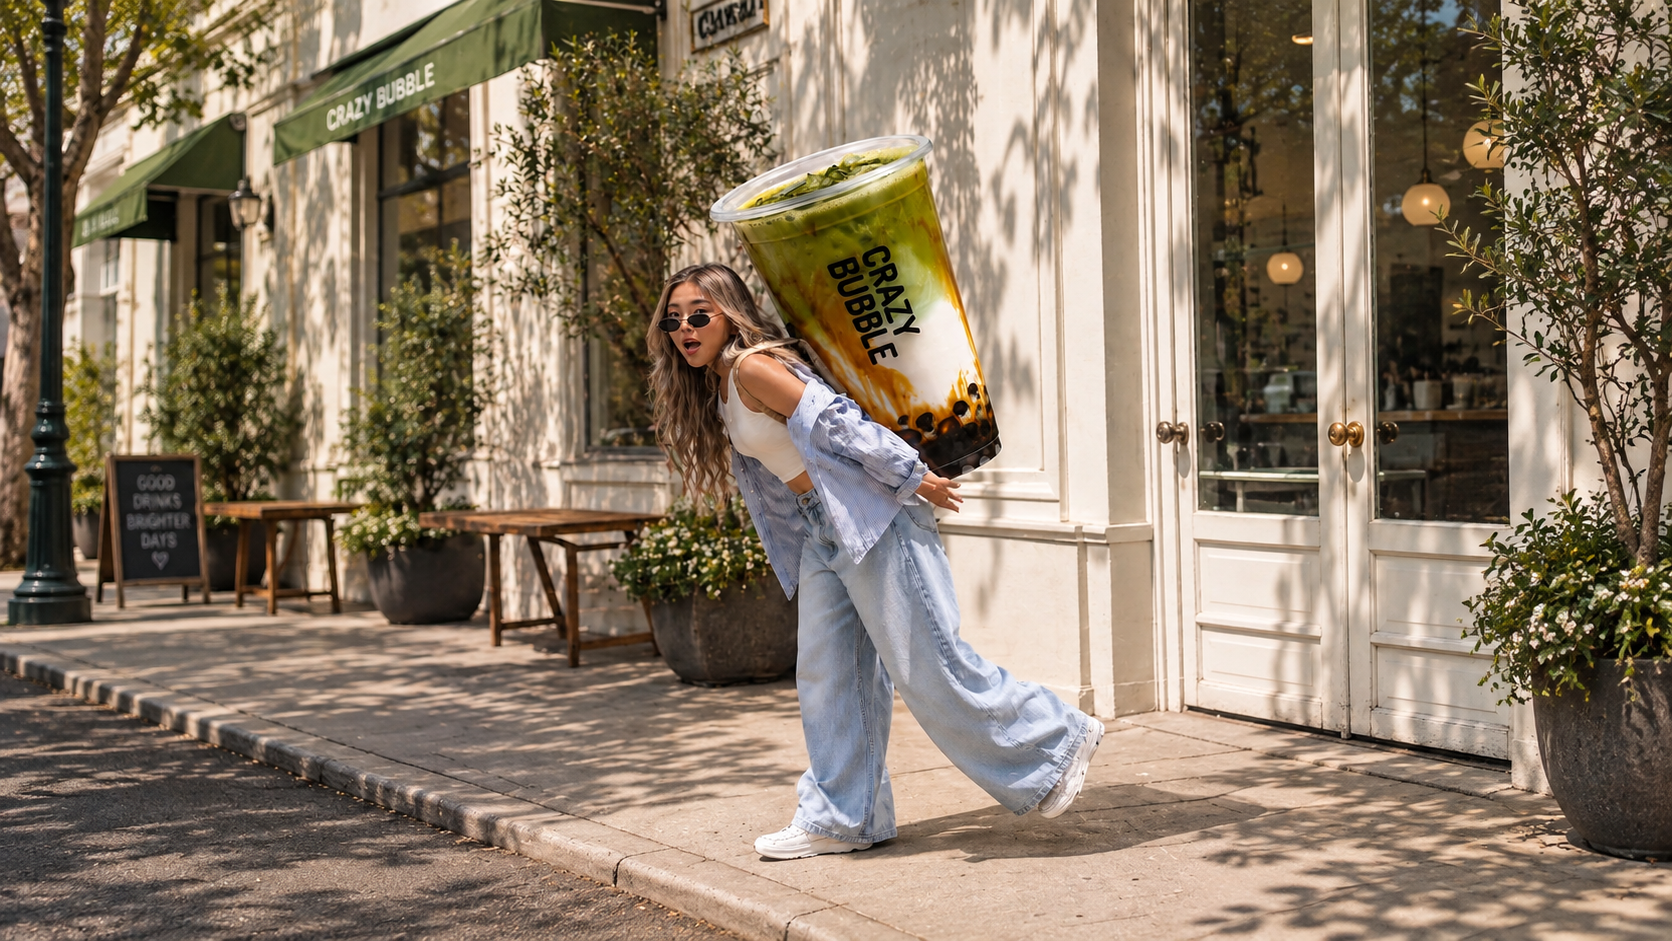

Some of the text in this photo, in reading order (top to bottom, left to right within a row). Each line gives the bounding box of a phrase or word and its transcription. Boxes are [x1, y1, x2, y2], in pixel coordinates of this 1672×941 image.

[326, 62, 435, 131] CRAZY BUBBLE
[862, 245, 921, 336] CRAZY
[827, 257, 899, 366] BUBBLE
[136, 473, 176, 491] GOOD
[132, 493, 183, 510] DRINKS
[126, 512, 192, 530] BRIGHTER
[140, 532, 178, 549] DAYS
